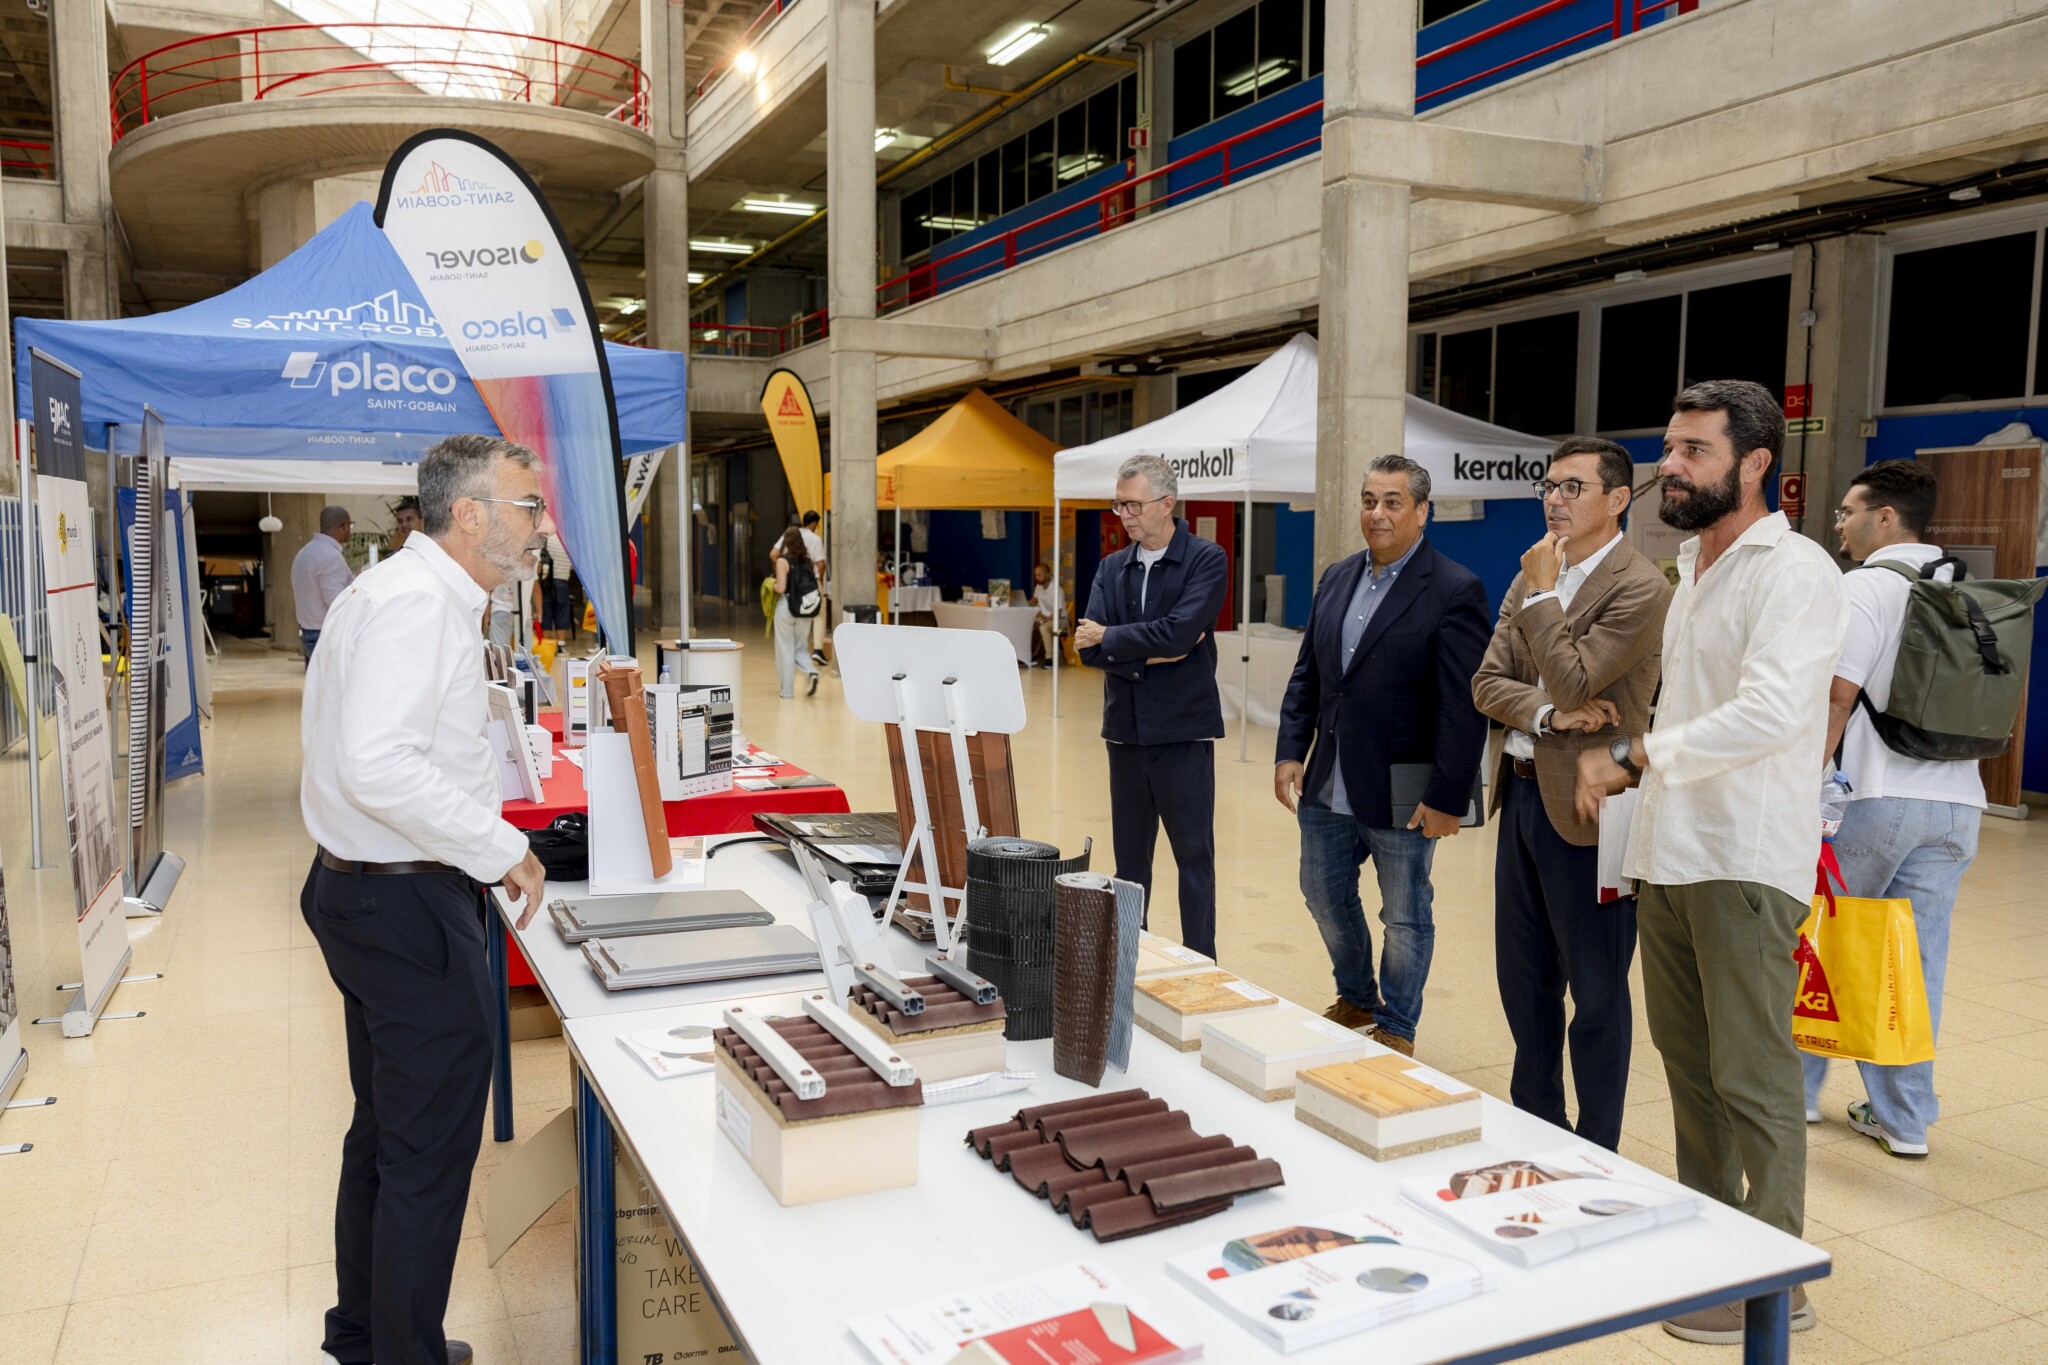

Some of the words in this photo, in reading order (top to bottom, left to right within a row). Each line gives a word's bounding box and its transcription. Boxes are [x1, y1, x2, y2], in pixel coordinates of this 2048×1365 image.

[231, 317, 447, 339] SAINT-GOB
[331, 352, 457, 396] placo
[367, 398, 457, 413] SAINT-GOBAIN
[1161, 448, 1234, 478] erakoll
[1454, 453, 1552, 480] kerakol
[1805, 1035, 1839, 1049] TRUST
[645, 1264, 700, 1289] TAKE
[642, 1292, 701, 1319] CARE
